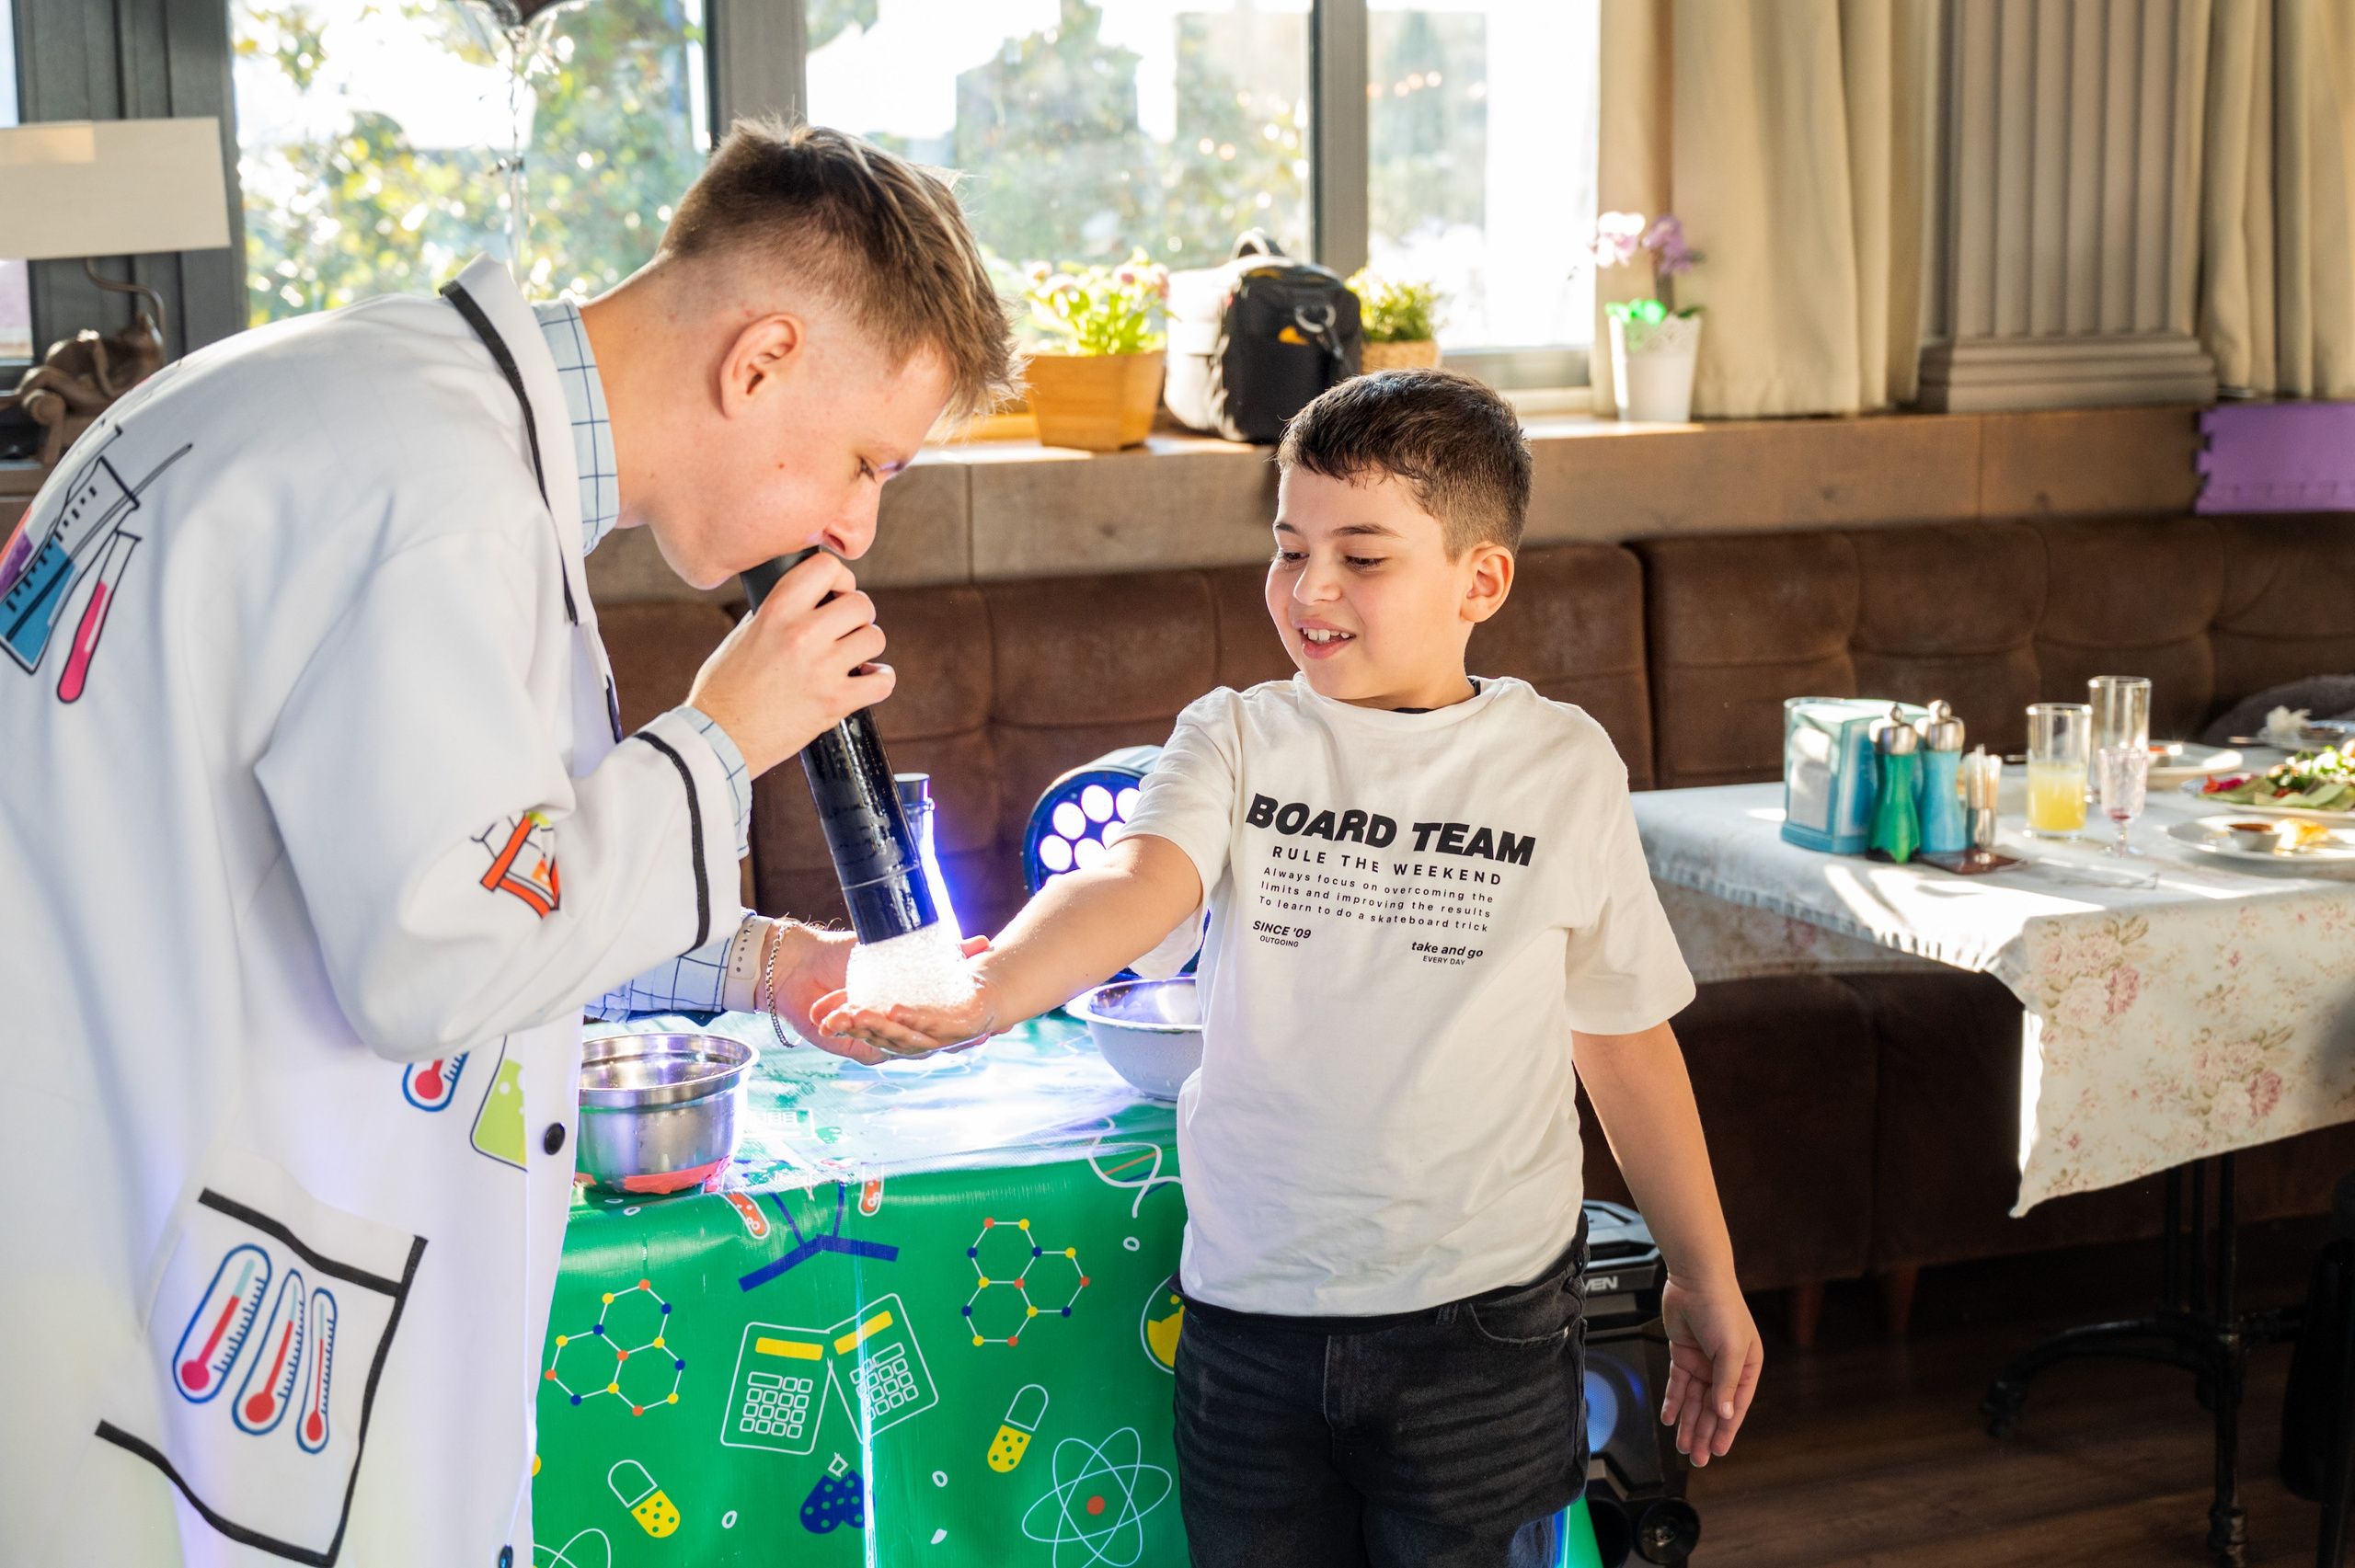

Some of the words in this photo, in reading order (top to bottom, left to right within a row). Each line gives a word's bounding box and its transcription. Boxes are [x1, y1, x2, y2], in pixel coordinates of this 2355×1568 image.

[1245, 792, 1398, 849] BOARD
[1411, 821, 1536, 867] TEAM
[1271, 845, 1327, 864] RULE
[1340, 854, 1379, 874] THE
[1393, 863, 1501, 886] WEEKEND
[1261, 880, 1300, 896] limits
[1305, 889, 1330, 899] and
[1336, 892, 1405, 910] improving
[1411, 901, 1434, 911] the
[1441, 906, 1490, 918] results
[1263, 866, 1311, 882] Always
[1317, 874, 1356, 887] focus
[1362, 882, 1378, 892] on
[1384, 887, 1465, 901] overcoming
[1472, 892, 1493, 903] the
[1252, 920, 1291, 936] SINCE
[1292, 927, 1312, 939] '09
[1259, 895, 1271, 906] To
[1277, 898, 1312, 912] learn
[1317, 906, 1331, 915] to
[1336, 908, 1352, 918] do
[1370, 914, 1449, 928] skateboard
[1455, 921, 1488, 933] trick
[1259, 934, 1299, 948] OUTGOING
[1411, 941, 1439, 954] take
[1441, 945, 1466, 956] and
[1466, 949, 1484, 960] go
[1422, 955, 1449, 964] EVERY
[1449, 957, 1465, 966] DAY
